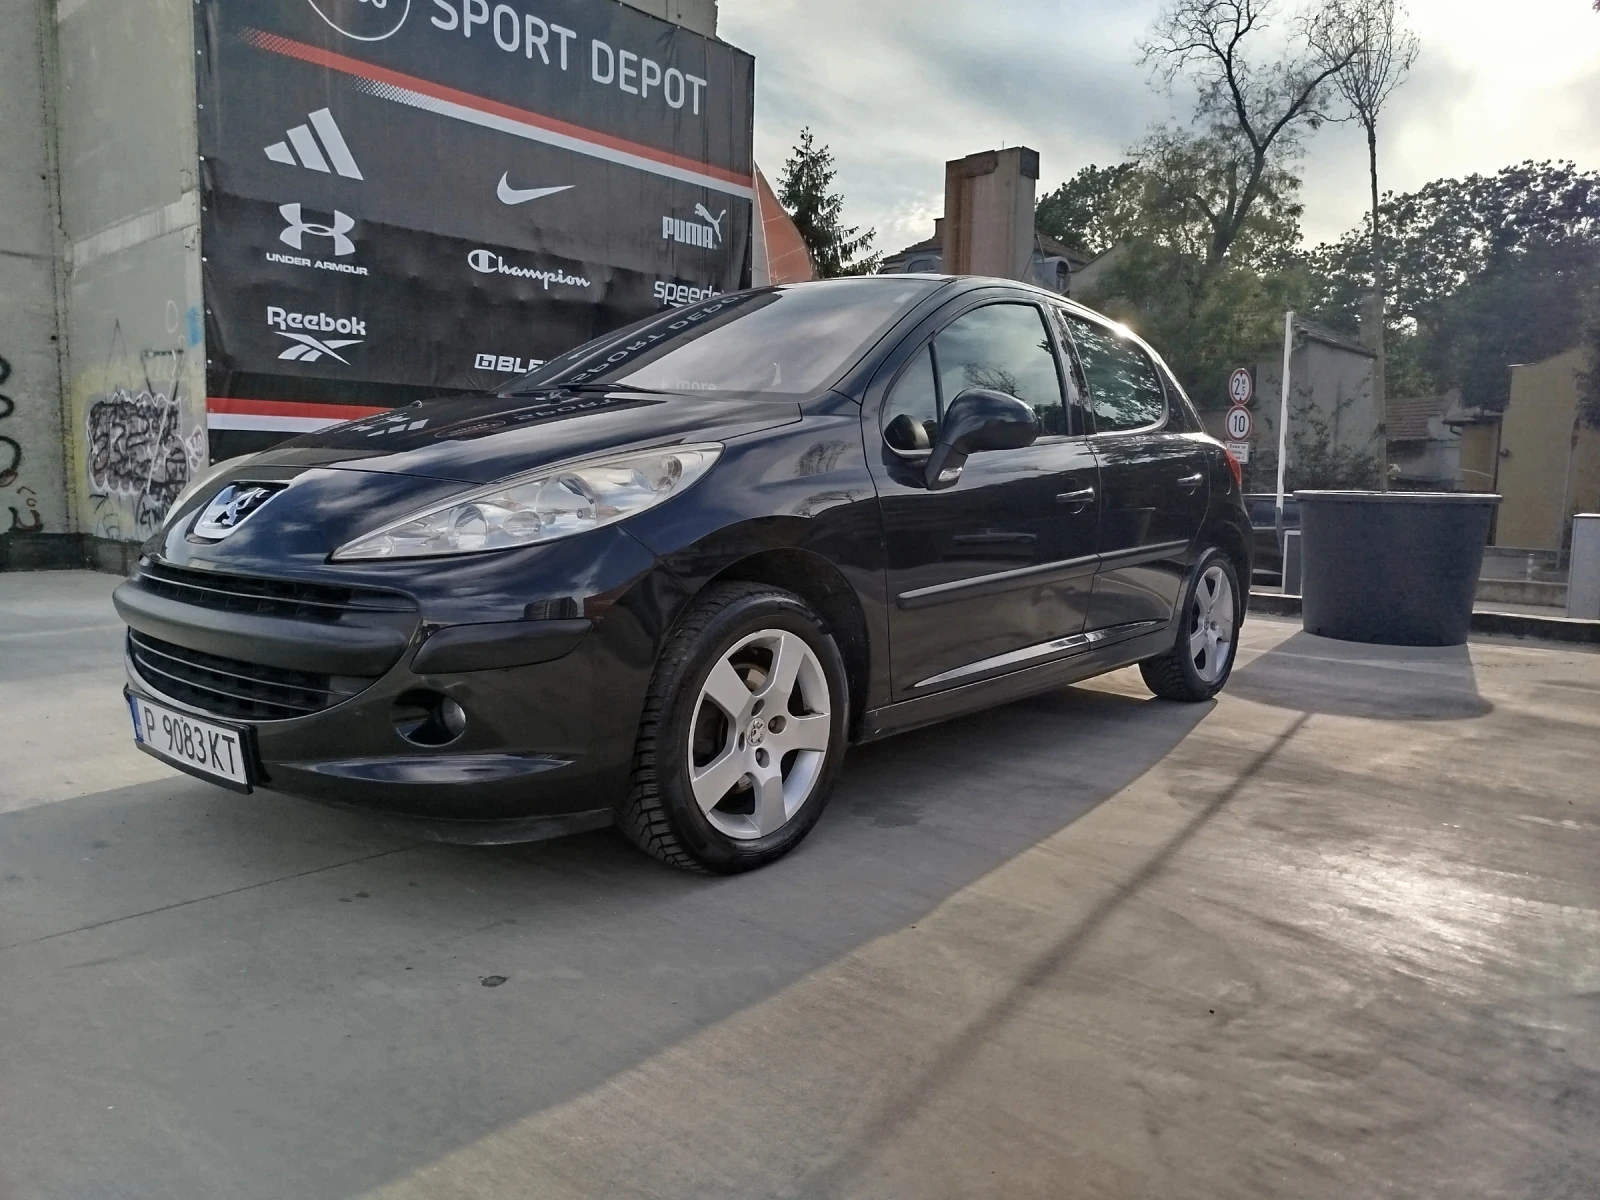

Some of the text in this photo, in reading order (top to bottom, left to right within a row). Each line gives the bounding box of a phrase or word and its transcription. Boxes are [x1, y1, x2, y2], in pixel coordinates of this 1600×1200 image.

[430, 0, 708, 116] SPORT DEPOT
[662, 215, 713, 250] PUMA
[265, 251, 370, 277] UNDER ARMOUR
[467, 249, 592, 290] Champion
[267, 305, 367, 336] Reebok
[1233, 415, 1246, 433] 10
[143, 705, 155, 743] P
